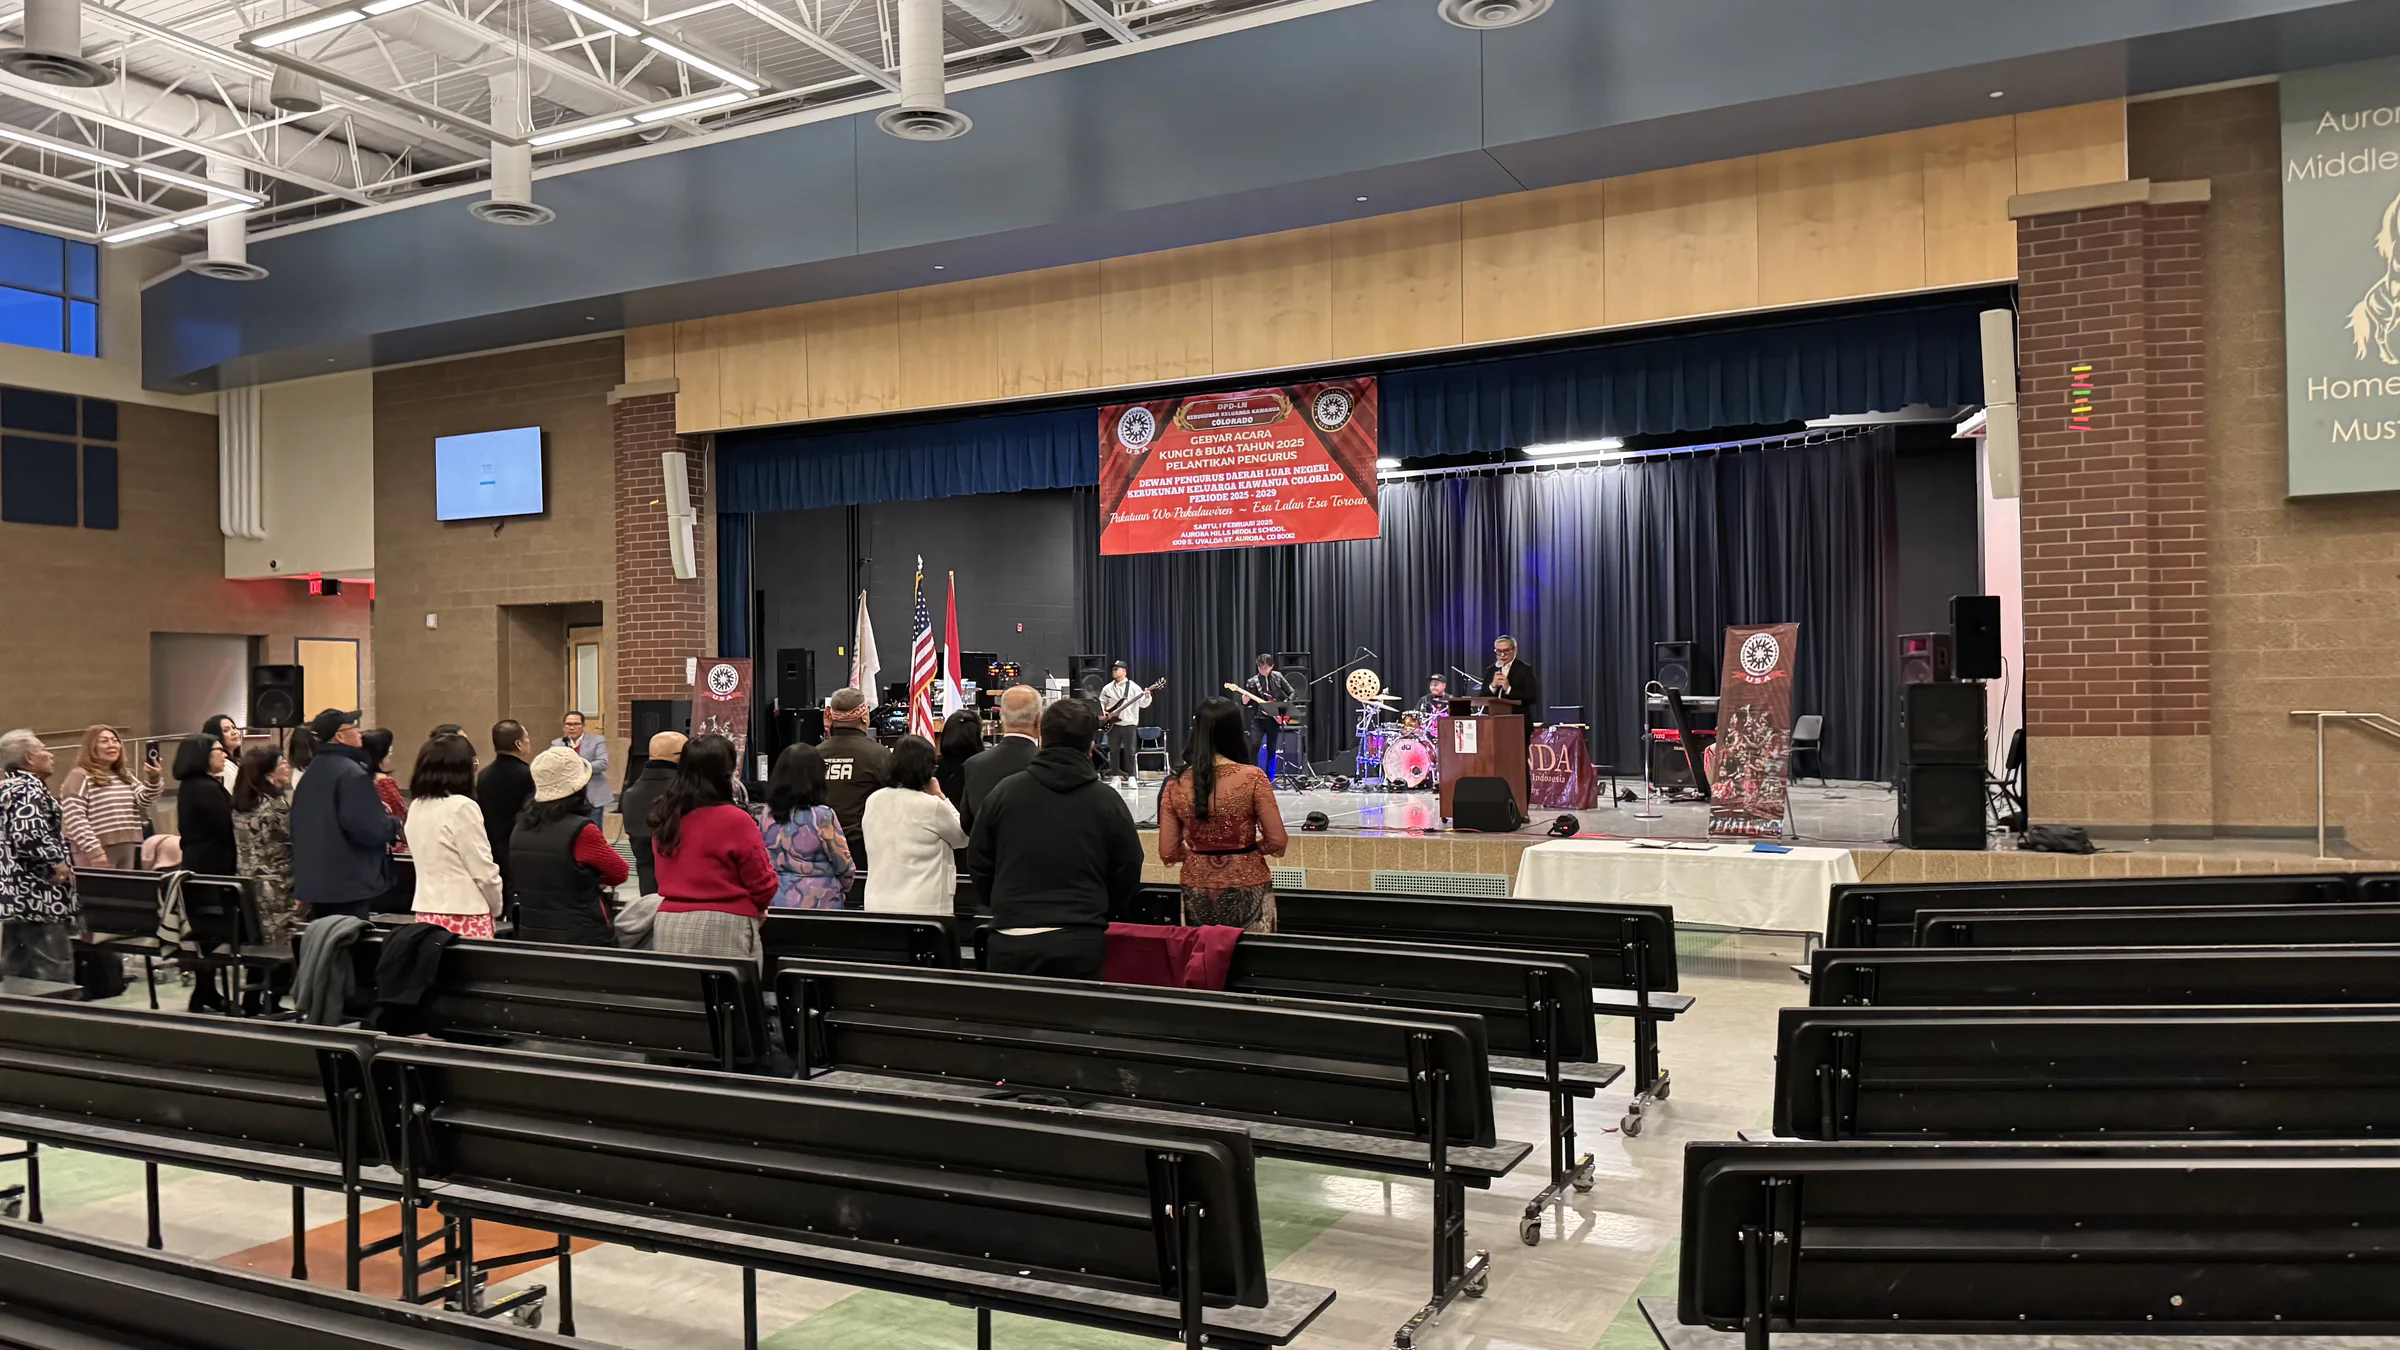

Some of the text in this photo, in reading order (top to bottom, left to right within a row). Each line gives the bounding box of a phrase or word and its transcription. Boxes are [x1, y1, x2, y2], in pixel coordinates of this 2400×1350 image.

[2287, 147, 2399, 182] Middle
[2308, 375, 2400, 402] Home
[1217, 402, 1248, 410] DPD-LN
[1212, 417, 1253, 426] COLORADO
[1190, 430, 1272, 445] GEBYAR ACARA
[1126, 446, 1149, 455] USA
[1160, 438, 1304, 460] KUNCI & BUKA TAHUN 2025
[1166, 451, 1298, 470] PELANTIKAN PENGURUS
[1139, 464, 1330, 488] DEWAN PENGURUS DAERAH LUAR NEGERI
[1127, 472, 1344, 498] KERUKUNAN KELUARGA KAWANUA COLORADO
[1189, 493, 1228, 504] PERIODE
[1230, 492, 1250, 500] 2025
[1256, 489, 1276, 498] 2029
[1110, 510, 1150, 524] Pakatuan
[1152, 508, 1172, 520] Wo
[1174, 504, 1233, 518] Pakalawiren
[1252, 502, 1272, 513] Esa
[1274, 498, 1304, 512] Lalan
[1308, 496, 1328, 509] Esa
[1330, 494, 1368, 508] Toroan
[1223, 520, 1255, 528] FEBRUARI
[1232, 528, 1258, 536] MIDDLE
[1258, 526, 1286, 534] SCHOOL
[1195, 537, 1223, 545] UVALDA
[1746, 675, 1771, 684] USA
